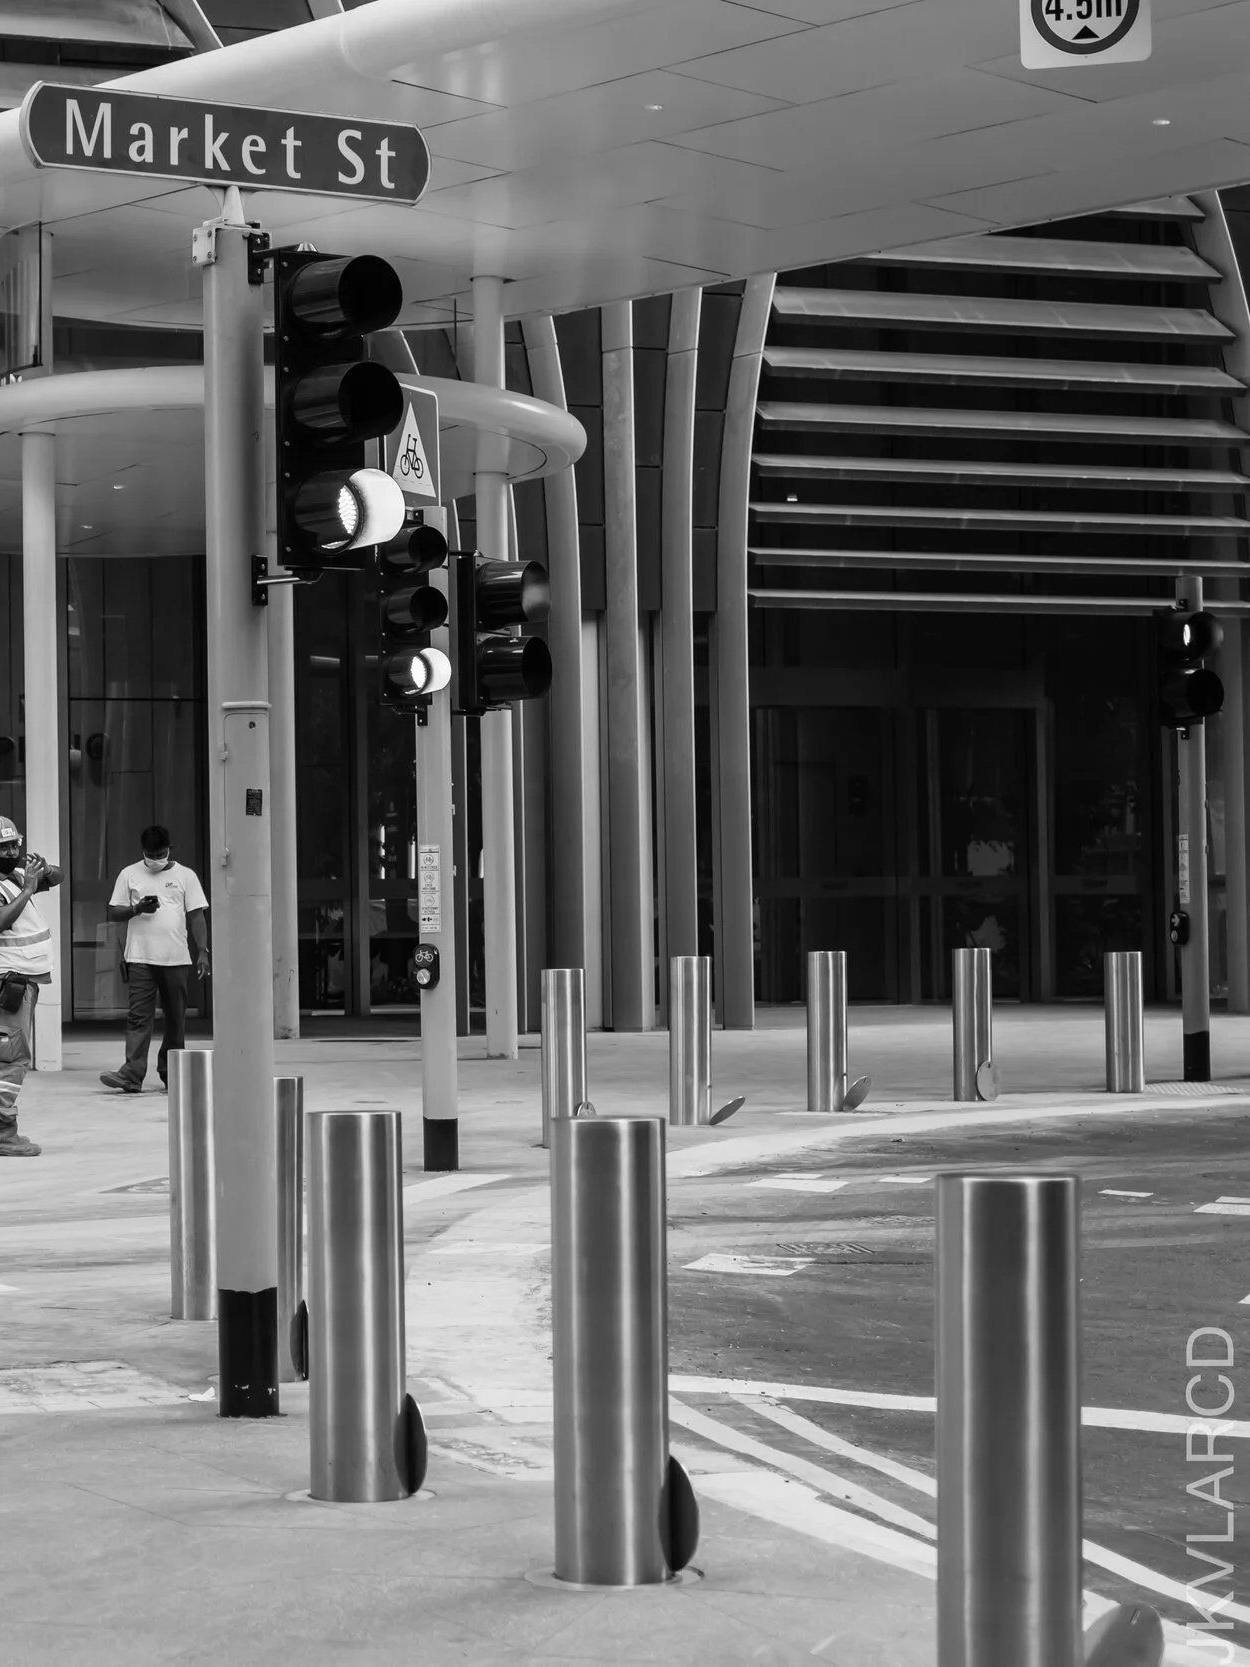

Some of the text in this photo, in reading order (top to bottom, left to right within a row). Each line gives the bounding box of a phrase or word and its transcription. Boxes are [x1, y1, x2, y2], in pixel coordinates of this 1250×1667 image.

[1045, 0, 1122, 21] 4.5m
[65, 98, 396, 189] Market St
